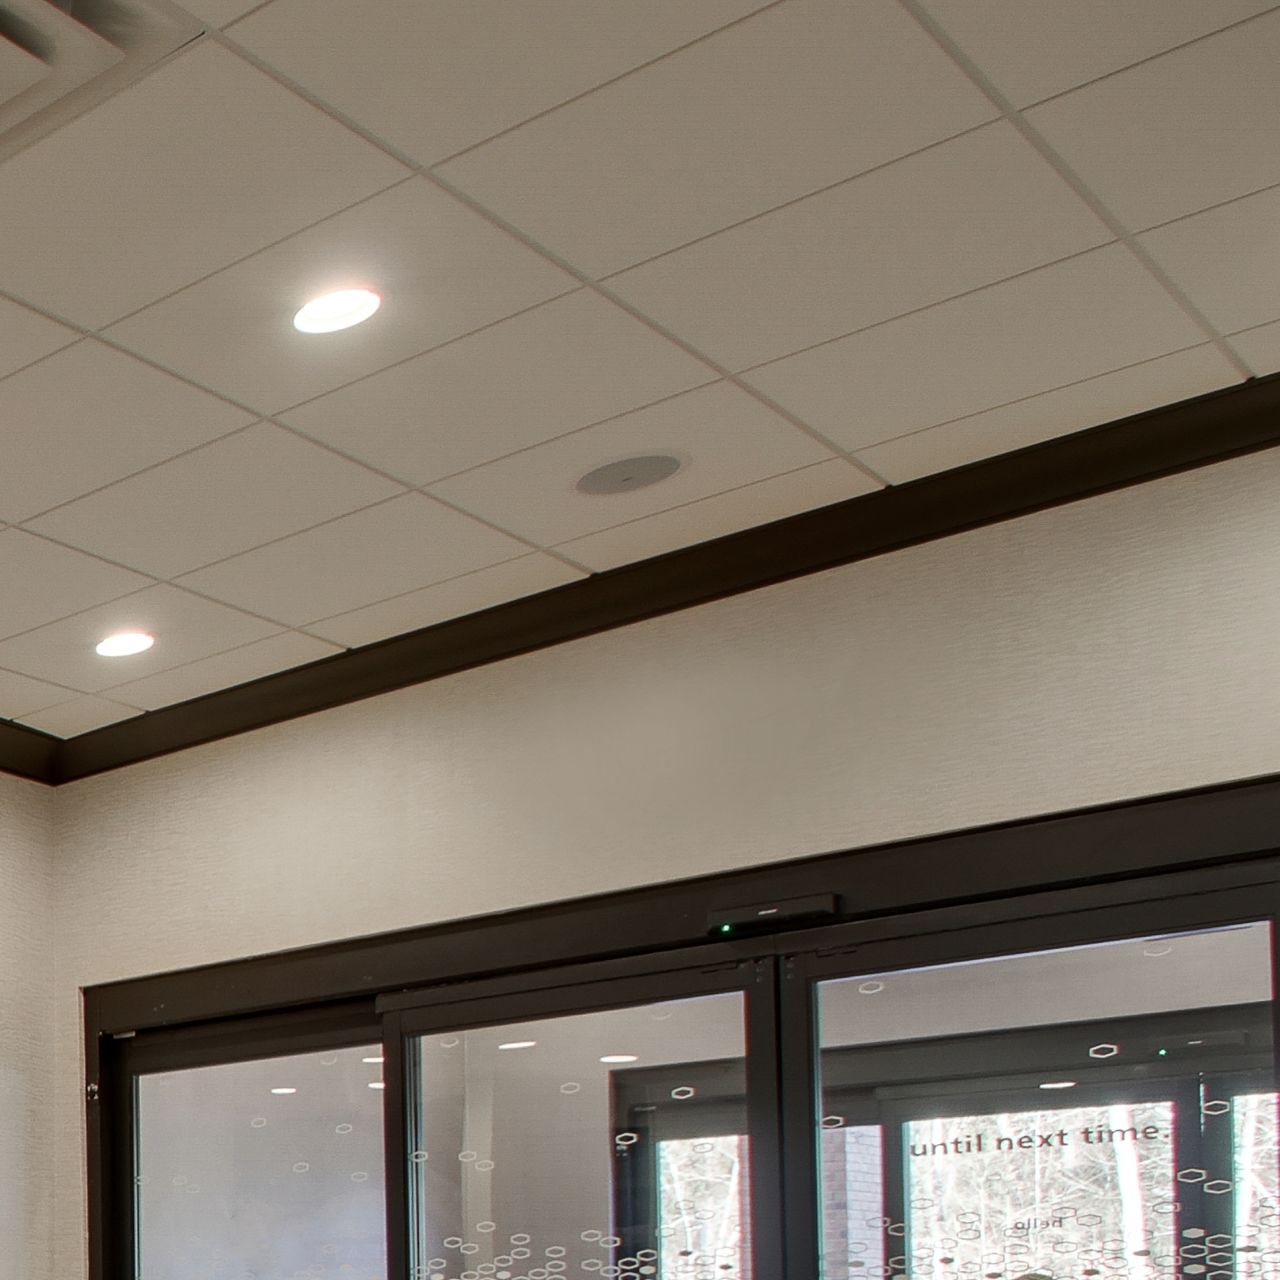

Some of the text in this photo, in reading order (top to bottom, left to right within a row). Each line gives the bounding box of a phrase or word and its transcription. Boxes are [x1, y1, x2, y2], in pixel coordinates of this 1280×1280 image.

[911, 1124, 1170, 1157] until next time.
